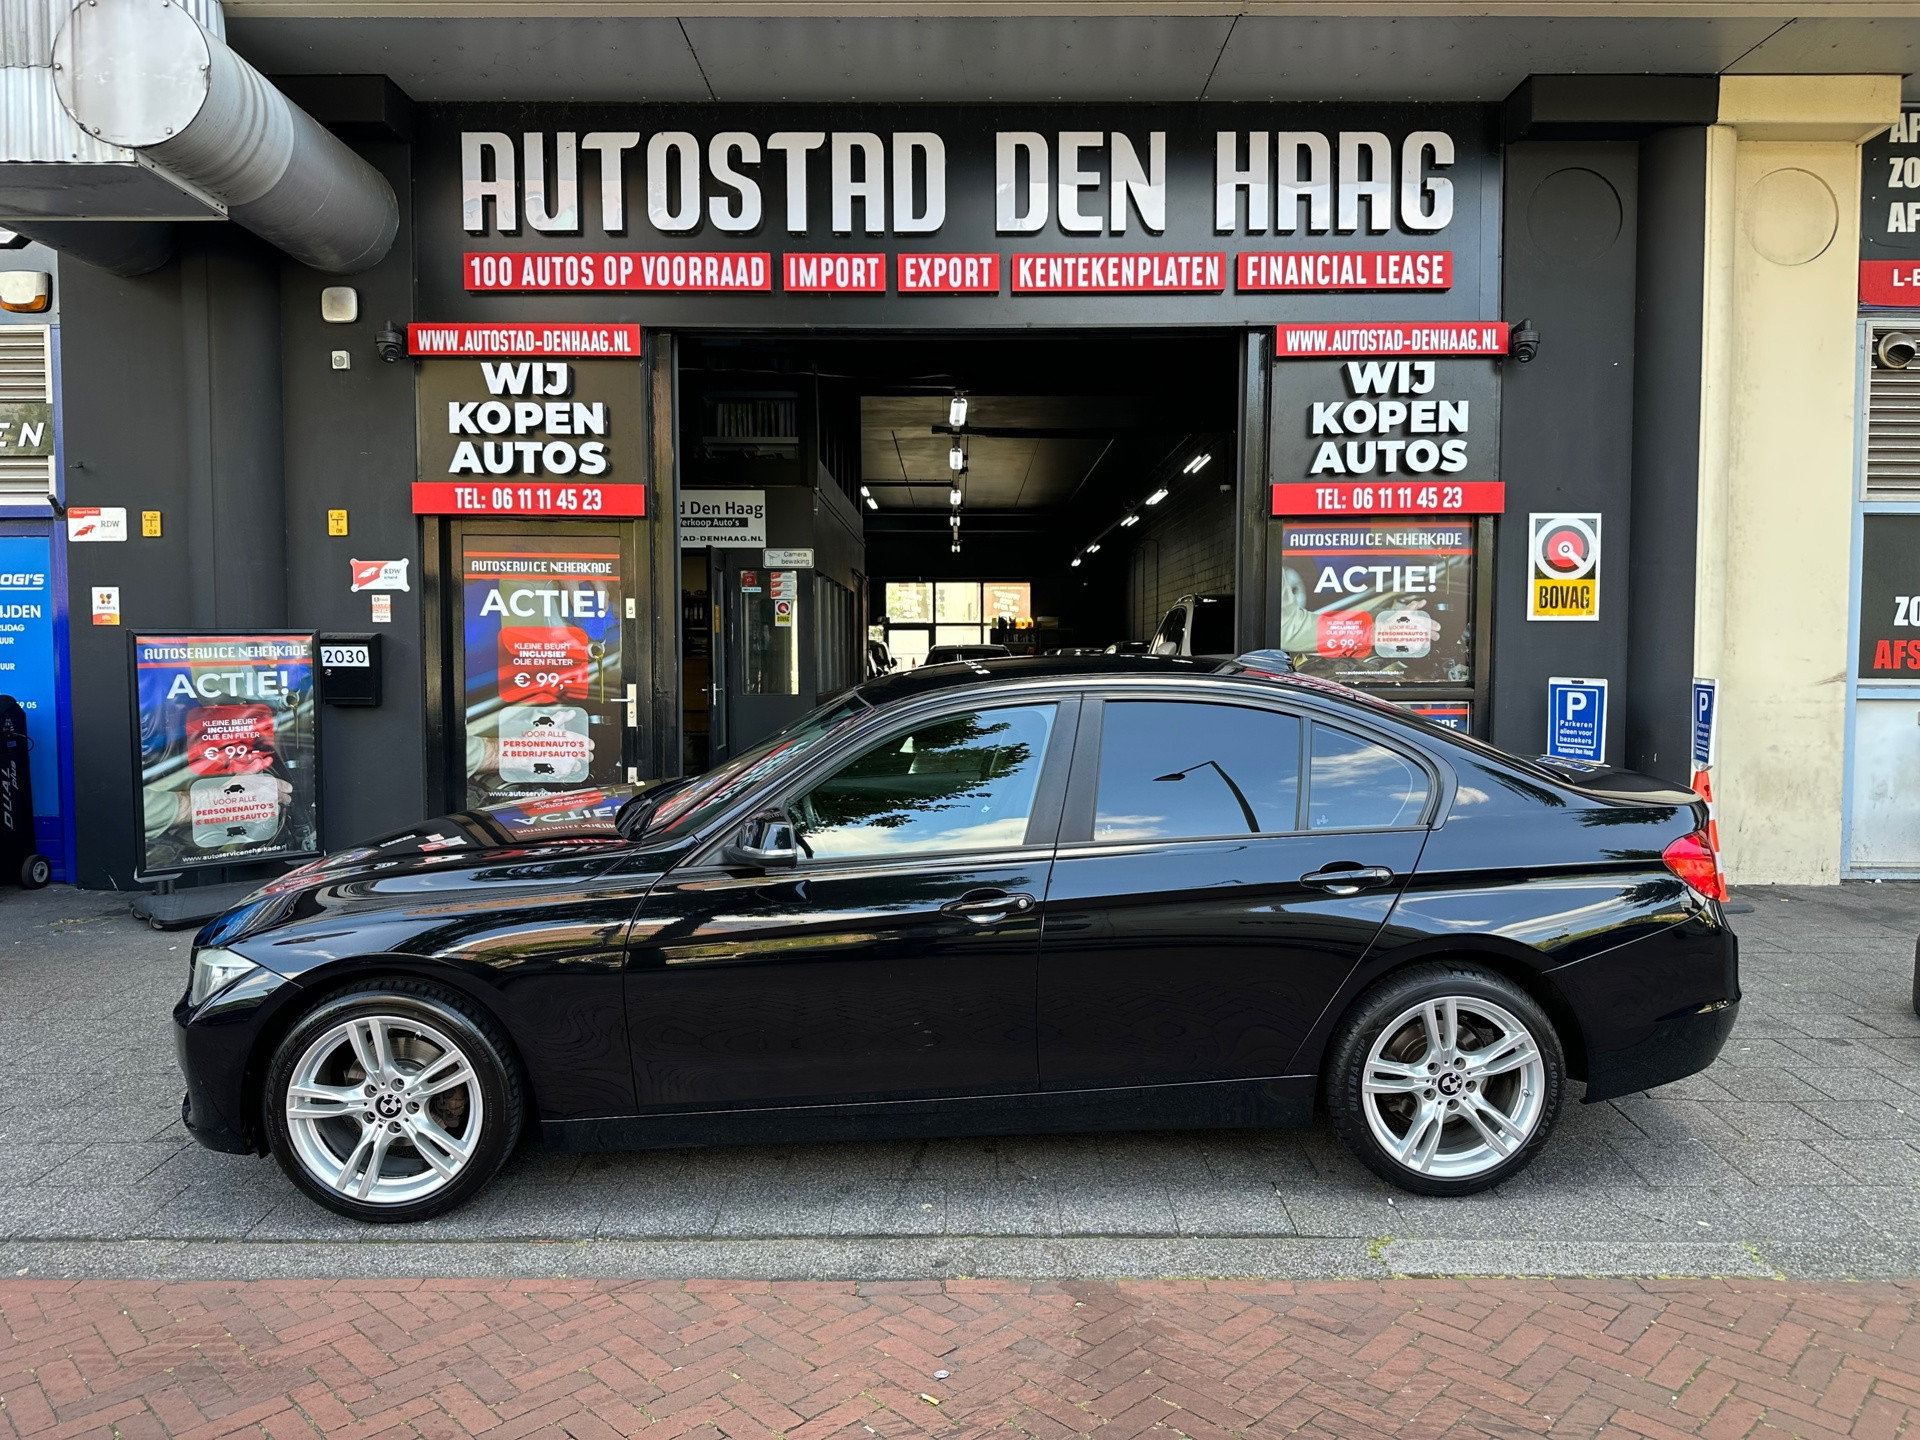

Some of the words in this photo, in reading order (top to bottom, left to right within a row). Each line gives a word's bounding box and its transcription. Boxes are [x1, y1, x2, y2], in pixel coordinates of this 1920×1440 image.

[461, 131, 946, 232] AUTOSTAD
[996, 131, 1166, 232] DEN
[1216, 131, 1454, 231] HAAG
[1888, 157, 1920, 188] ZO
[1887, 202, 1920, 232] AF
[471, 256, 512, 286] 100
[521, 256, 594, 286] AUTOS
[603, 256, 633, 287] OP
[642, 256, 765, 287] VOORRAAD
[789, 257, 879, 288] IMPORT
[905, 257, 992, 288] EXPORT
[1019, 256, 1219, 288] KENTEKENPLATEN
[1247, 254, 1366, 286] FINANCIAL
[1375, 254, 1444, 285] LEASE
[418, 329, 632, 353] WWW.AUTOSTAD-DENHAAG.NL
[1286, 328, 1500, 352] WWW.AUTOSTAD-DENHAAG.NL
[480, 362, 568, 395] WIJ
[1347, 361, 1436, 394] WIJ
[448, 401, 604, 435] KOPEN
[1312, 400, 1469, 434] KOPEN
[448, 441, 607, 475] AUTOS
[1310, 439, 1468, 474] AUTOS
[455, 487, 486, 509] TEL:
[492, 488, 513, 509] 06
[518, 488, 532, 509] 11
[537, 488, 551, 509] 11
[556, 489, 578, 510] 45
[582, 489, 602, 510] 23
[690, 501, 721, 515] Den
[725, 501, 764, 518] Haag
[1316, 488, 1347, 509] TEL:
[1353, 488, 1373, 509] 06
[1378, 488, 1392, 508] 11
[1397, 488, 1411, 508] 11
[1416, 487, 1438, 508] 45
[1442, 487, 1463, 508] 23
[100, 520, 120, 528] RDW
[713, 517, 740, 527] Auto's
[1290, 533, 1382, 547] AUTOSERVICE
[1386, 532, 1462, 546] NEHERKADE
[471, 560, 547, 572] AUTOSERVICE
[550, 562, 612, 574] NEHERKADE
[781, 558, 810, 566] bewaking
[1314, 565, 1437, 593] ACTIE!
[480, 589, 606, 618] ACTIE!
[1539, 585, 1590, 609] BOVAG
[1894, 596, 1920, 627] ZO
[144, 647, 235, 660] AUTOSERVICE
[238, 645, 308, 658] NEHERKADE
[323, 649, 366, 663] 2030
[1327, 639, 1337, 649] €
[1340, 639, 1363, 650] 99,-
[1873, 640, 1920, 669] AFS
[534, 658, 545, 666] EN
[547, 658, 573, 666] FILTER
[166, 670, 290, 699] ACTIE!
[514, 672, 531, 688] €
[536, 672, 573, 690] 99,-
[1567, 692, 1587, 720] P
[1699, 692, 1708, 722] P
[202, 719, 229, 727] KLEINE
[231, 718, 257, 726] BEURT
[207, 725, 254, 733] INCLUSIEF
[1560, 720, 1593, 728] Parkeren
[235, 731, 260, 739] FILTER
[1560, 735, 1592, 744] bezoekers
[203, 746, 220, 760] €
[225, 745, 260, 760] 99,-
[511, 750, 586, 758] BEDRIJFSAUTO'S
[10, 760, 19, 790] plus
[1, 768, 13, 830] DUAL
[196, 803, 275, 817] PERSONENAUTO'S
[213, 797, 237, 805] VOOR
[239, 795, 257, 803] ALLE
[204, 811, 277, 825] BEDRIJFSAUTO'S
